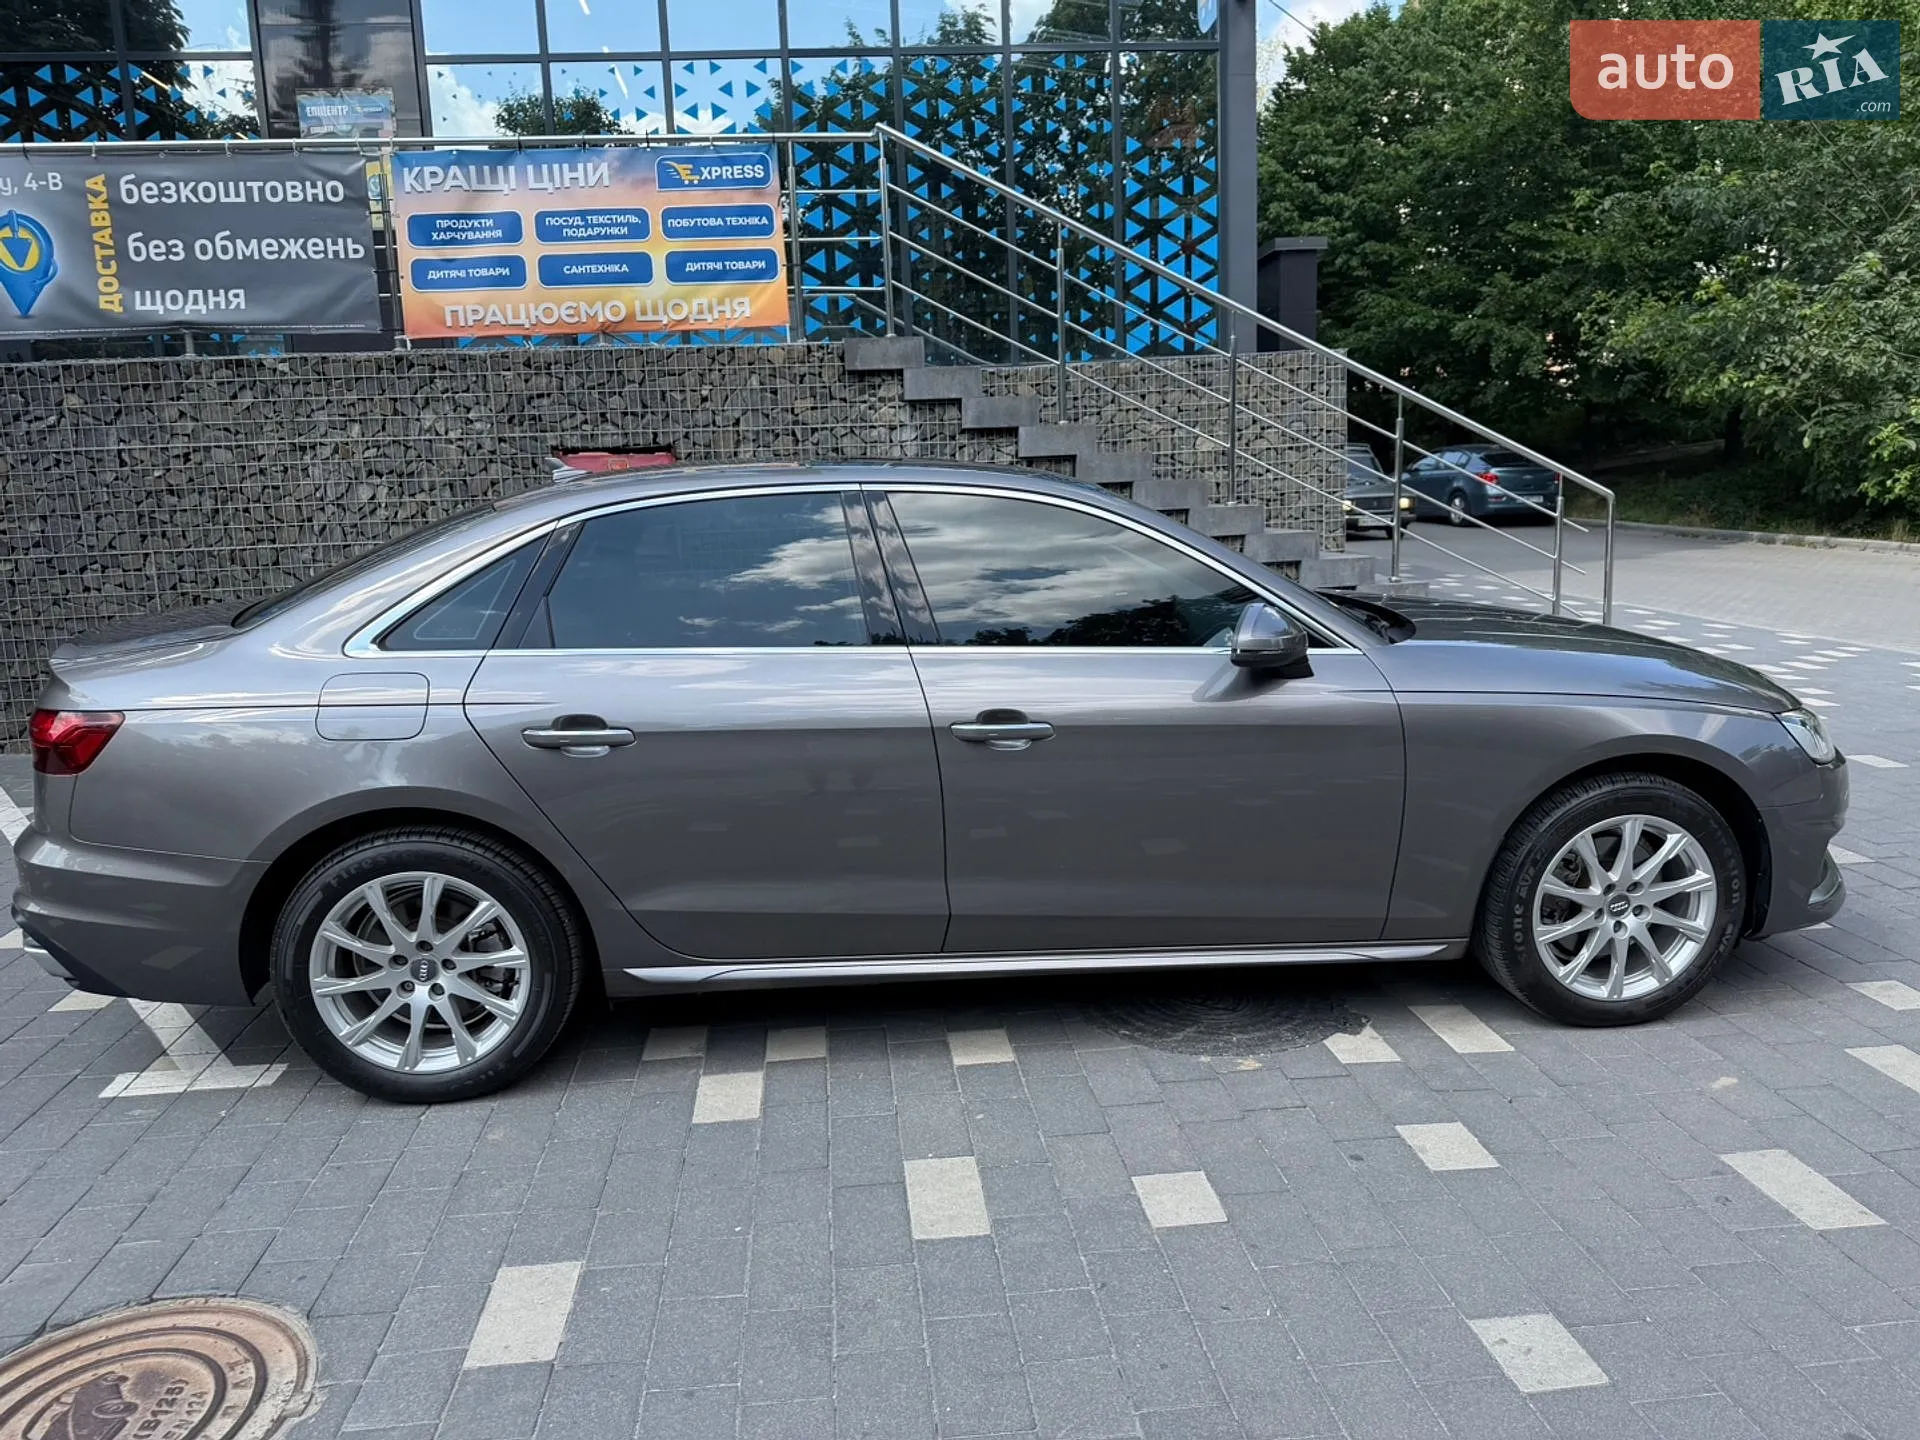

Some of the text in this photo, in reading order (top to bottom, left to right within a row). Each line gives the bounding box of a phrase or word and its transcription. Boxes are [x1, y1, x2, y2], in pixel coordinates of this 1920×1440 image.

[402, 161, 611, 196] КРАЩІ ЦІНИ
[119, 173, 345, 205] безкоштовно
[435, 217, 494, 229] ПРОДУКТИ
[667, 215, 769, 228] ПОБУТОВА ТЕХНІКА
[431, 228, 503, 241] ХАРЧУВАННЯ
[562, 225, 628, 238] ПОДАРУНКИ
[85, 173, 124, 313] ДОСТАВКА
[127, 230, 366, 262] без обмежень
[563, 262, 630, 274] САНТЕХНІКА
[685, 260, 766, 272] ДИТЯЧІ ТОВАРИ
[426, 267, 510, 280] ДИТЯЧІ ТОВАРИ
[134, 288, 247, 314] щодня
[443, 296, 751, 329] ПРАЦЮЄМО ЩОДНЯ
